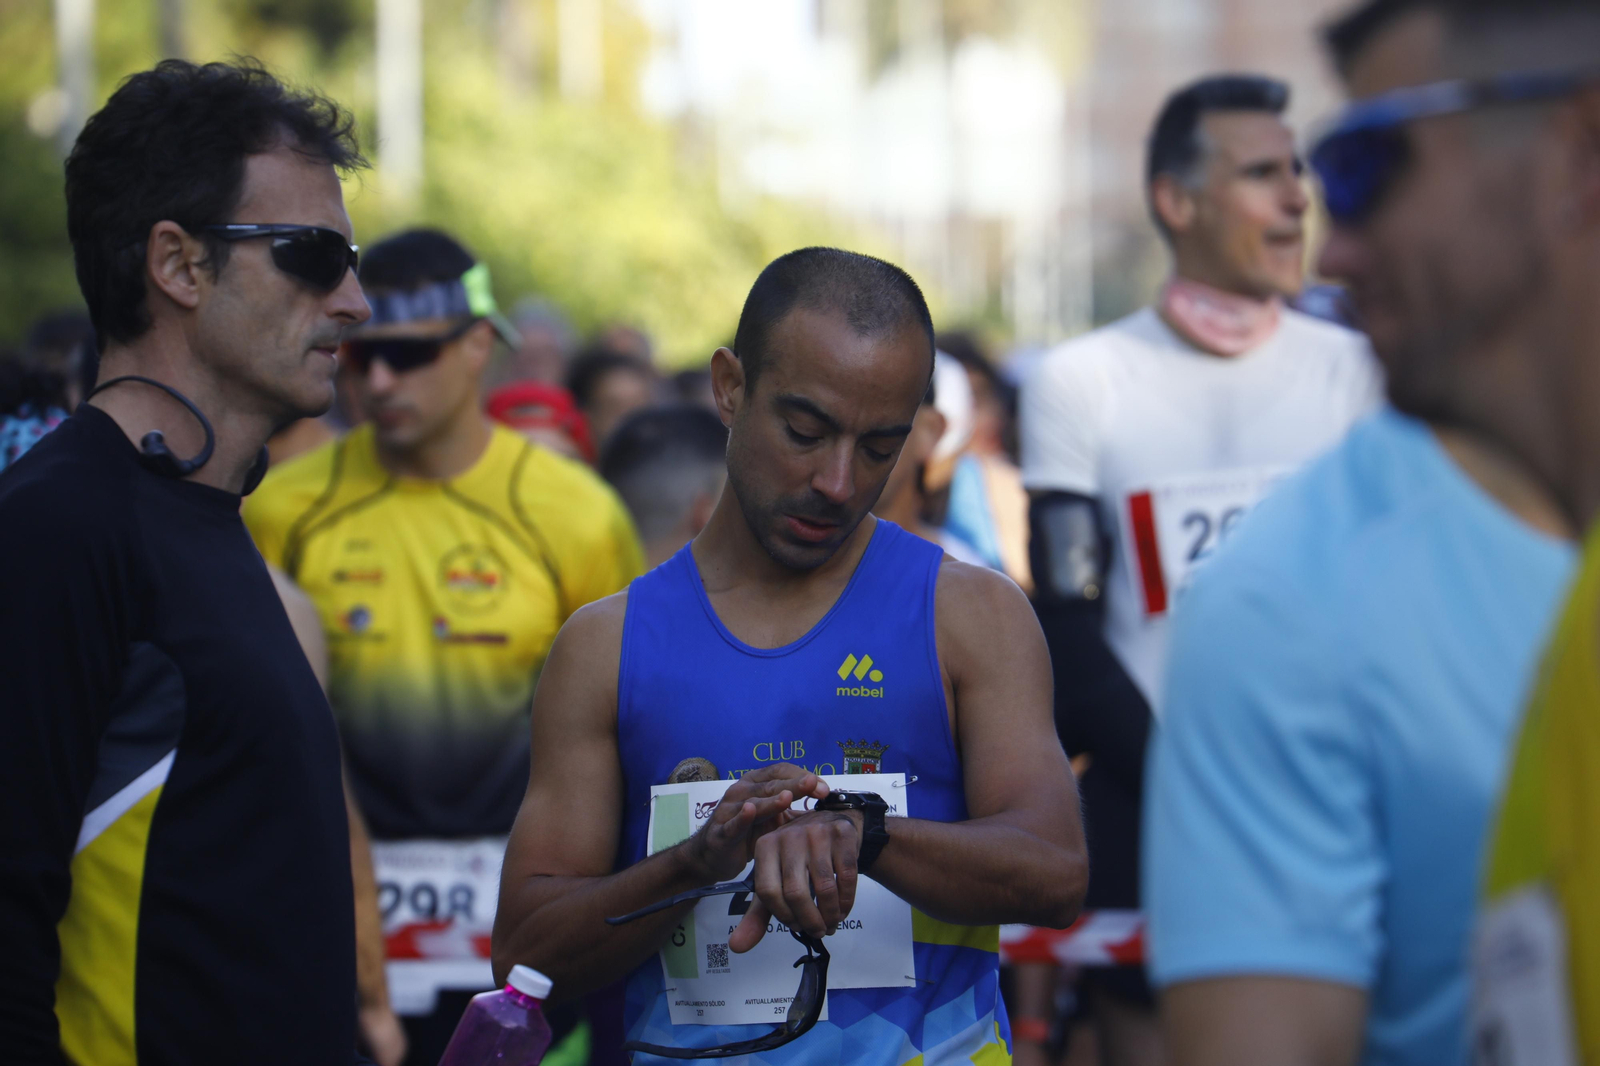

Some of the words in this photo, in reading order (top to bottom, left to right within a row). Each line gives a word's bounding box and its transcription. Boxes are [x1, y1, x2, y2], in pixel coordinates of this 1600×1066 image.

[837, 686, 884, 698] mobel
[753, 740, 805, 762] CLUB
[836, 919, 863, 930] ENCA
[745, 997, 796, 1005] AVITUALLAMIENTO
[774, 1006, 786, 1015] 257
